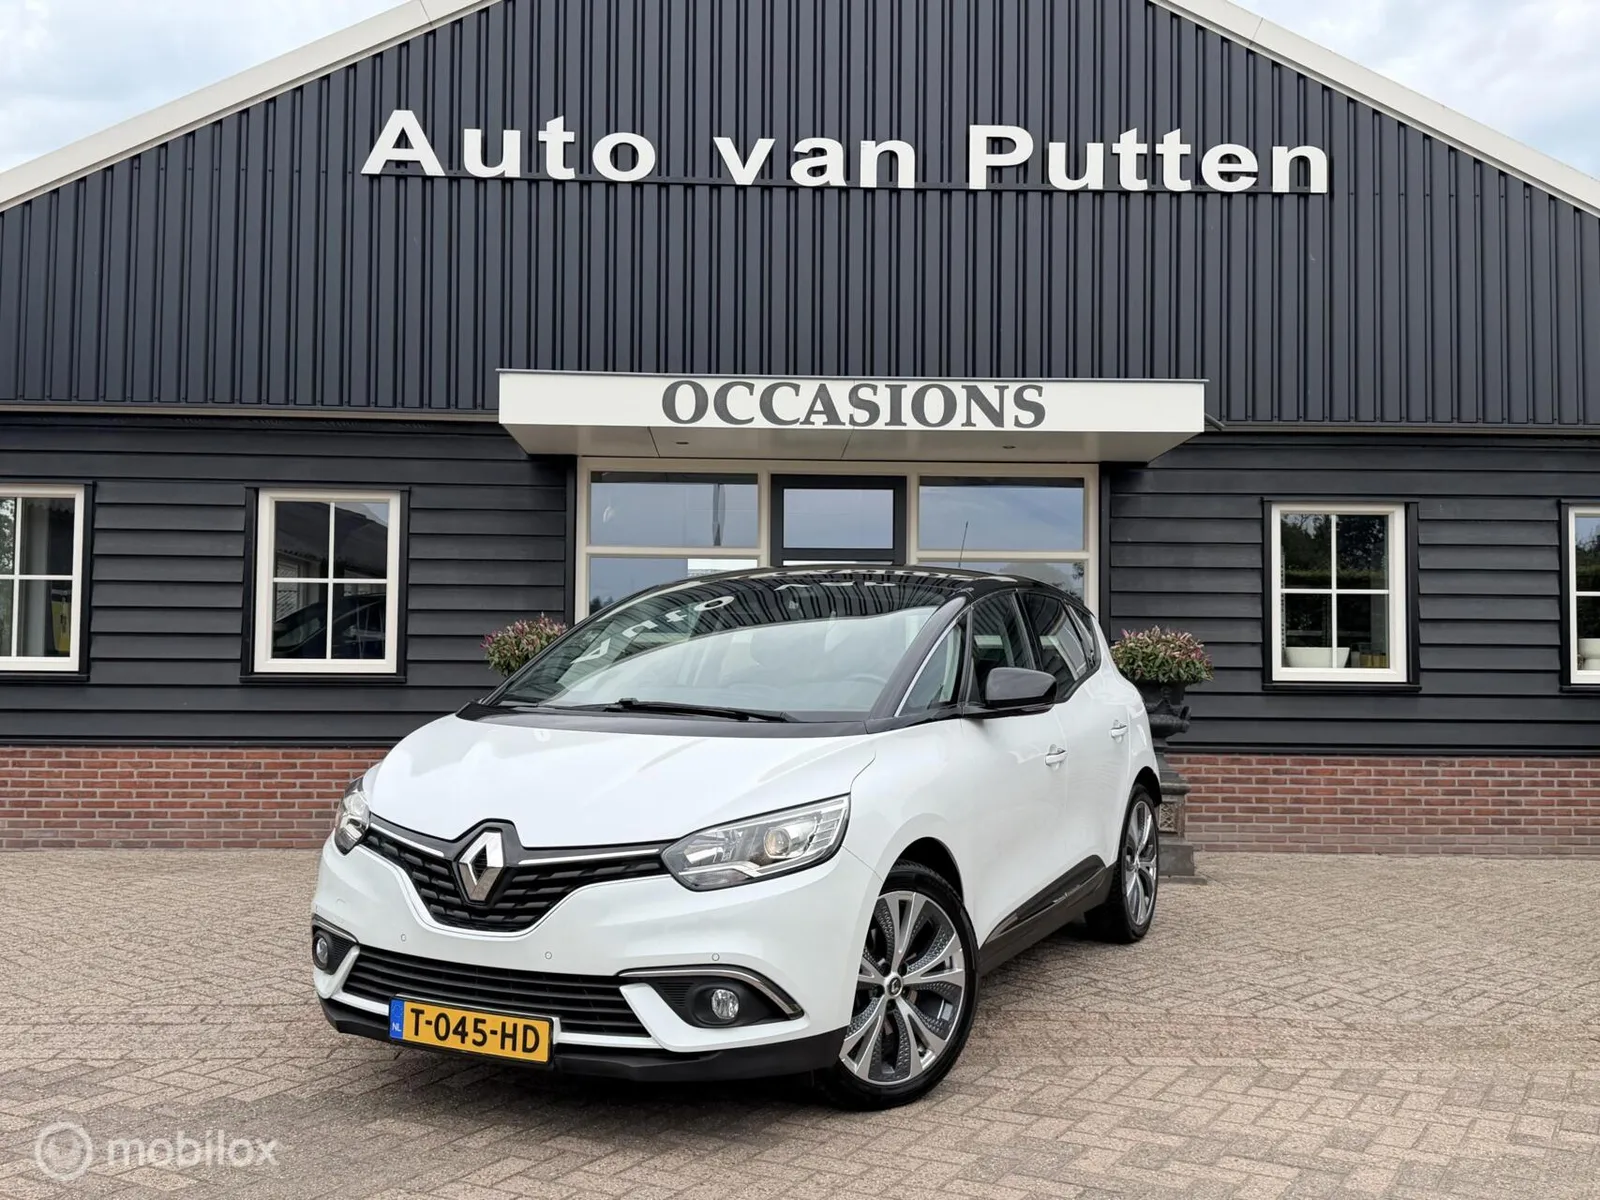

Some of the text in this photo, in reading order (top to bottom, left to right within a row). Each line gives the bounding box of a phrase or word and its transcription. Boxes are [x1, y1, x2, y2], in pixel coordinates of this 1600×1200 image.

[361, 109, 1328, 193] Auto van Putten
[662, 379, 1046, 429] OCCASIONS
[391, 1022, 402, 1032] NL
[410, 1008, 540, 1054] T-045-HD
